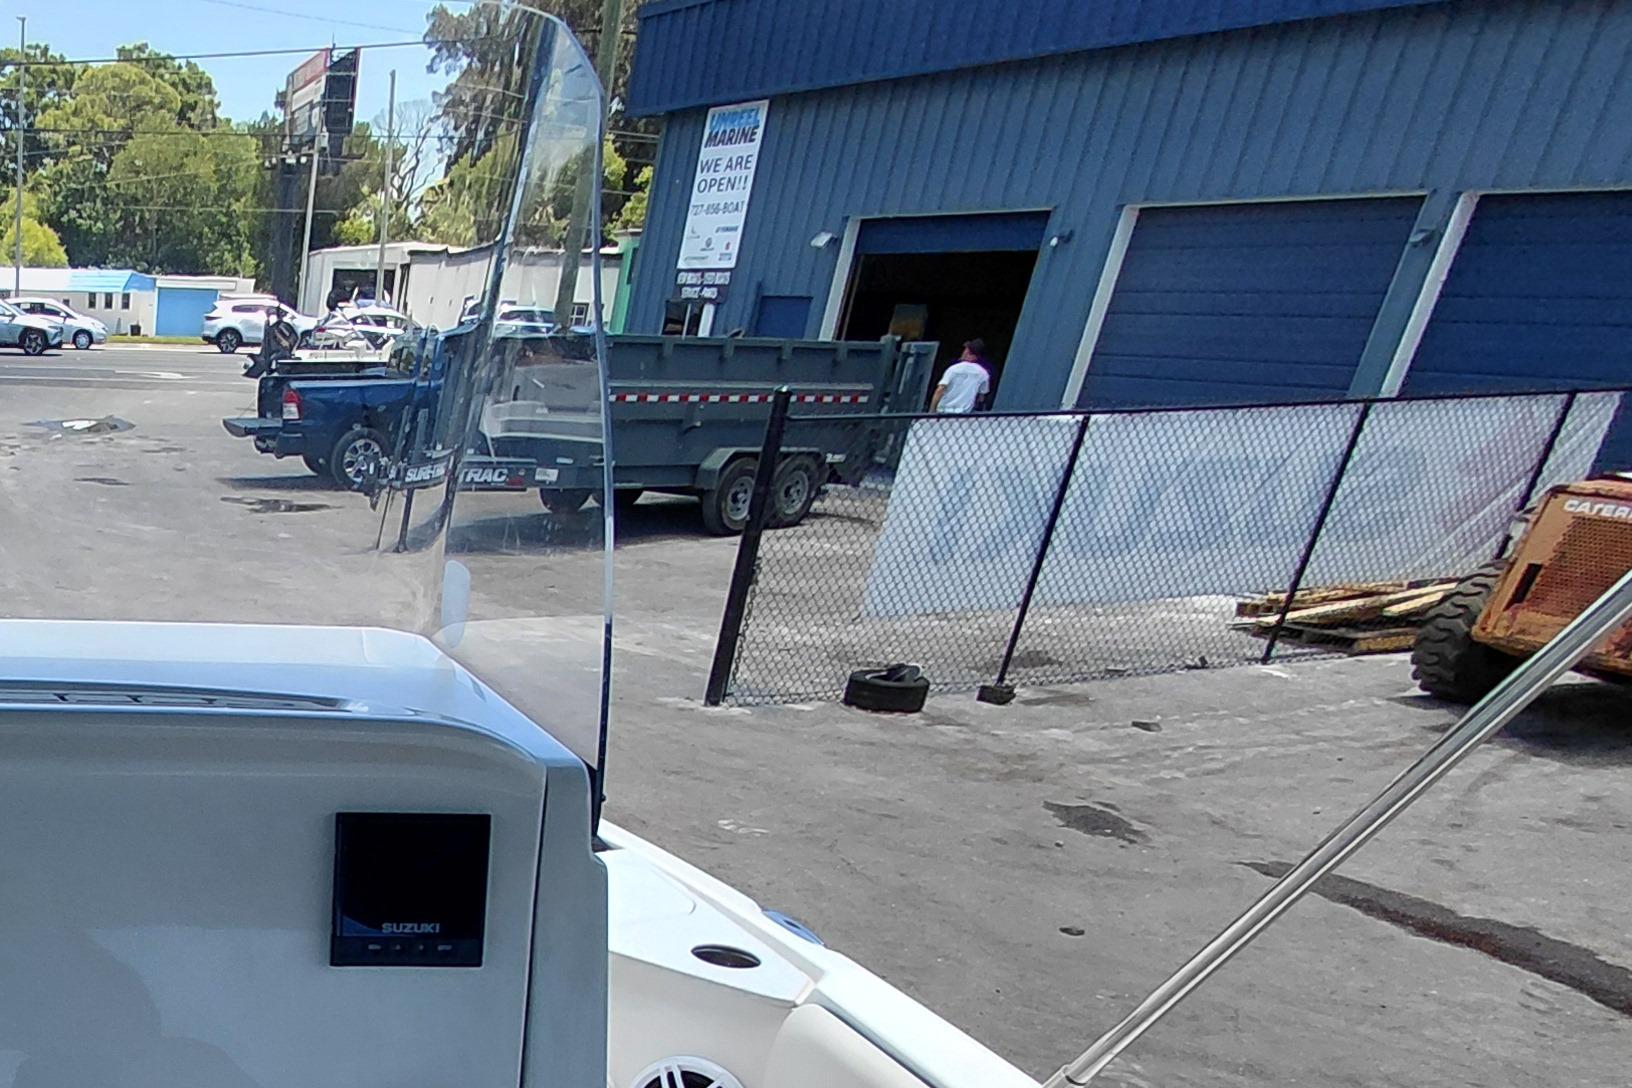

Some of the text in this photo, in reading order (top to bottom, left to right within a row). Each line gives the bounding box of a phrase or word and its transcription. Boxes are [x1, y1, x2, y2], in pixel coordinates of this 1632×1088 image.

[704, 125, 760, 148] MARINE
[700, 155, 754, 174] WE ARE
[697, 175, 749, 193] OPEN!!
[1564, 500, 1632, 518] CATER
[381, 922, 441, 934] SUZUKI
